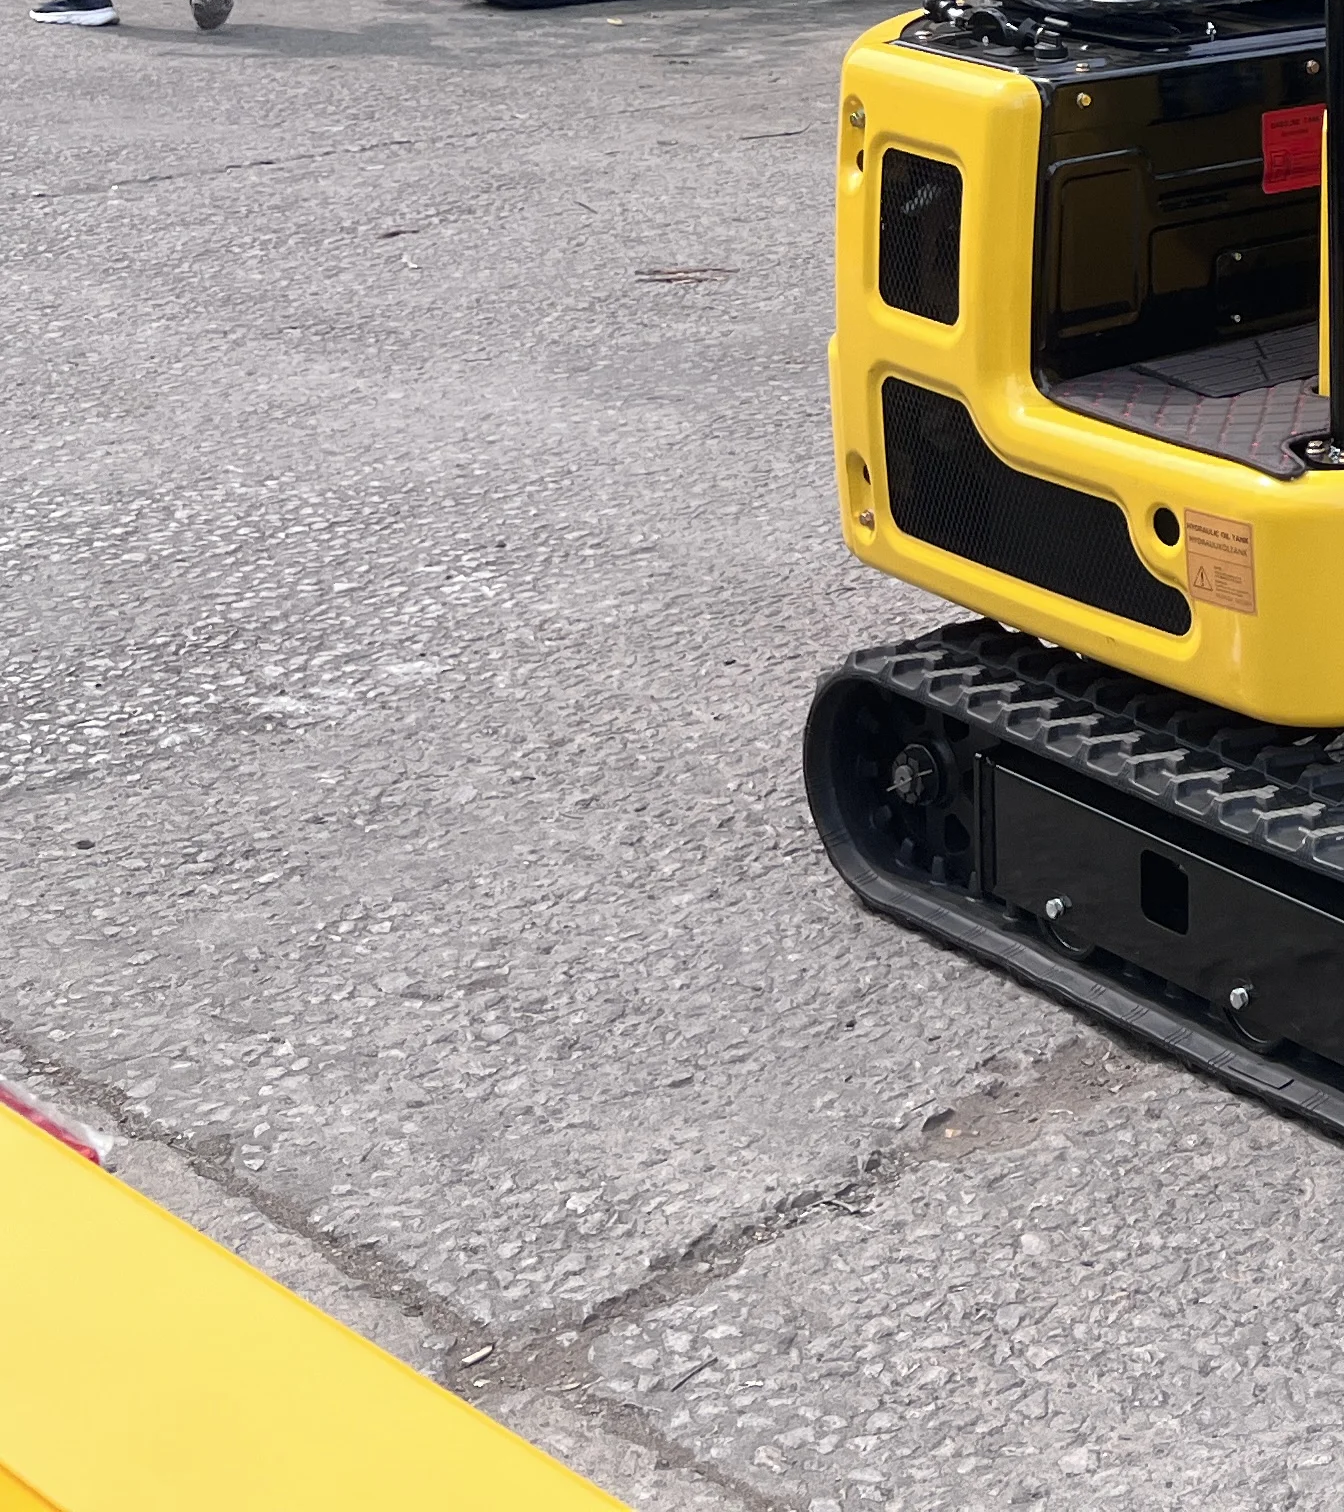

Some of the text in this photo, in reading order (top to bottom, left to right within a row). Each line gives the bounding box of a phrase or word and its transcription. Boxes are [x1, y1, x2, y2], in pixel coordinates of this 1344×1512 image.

[1186, 522, 1249, 545] HYDRAULIC OIL TANK
